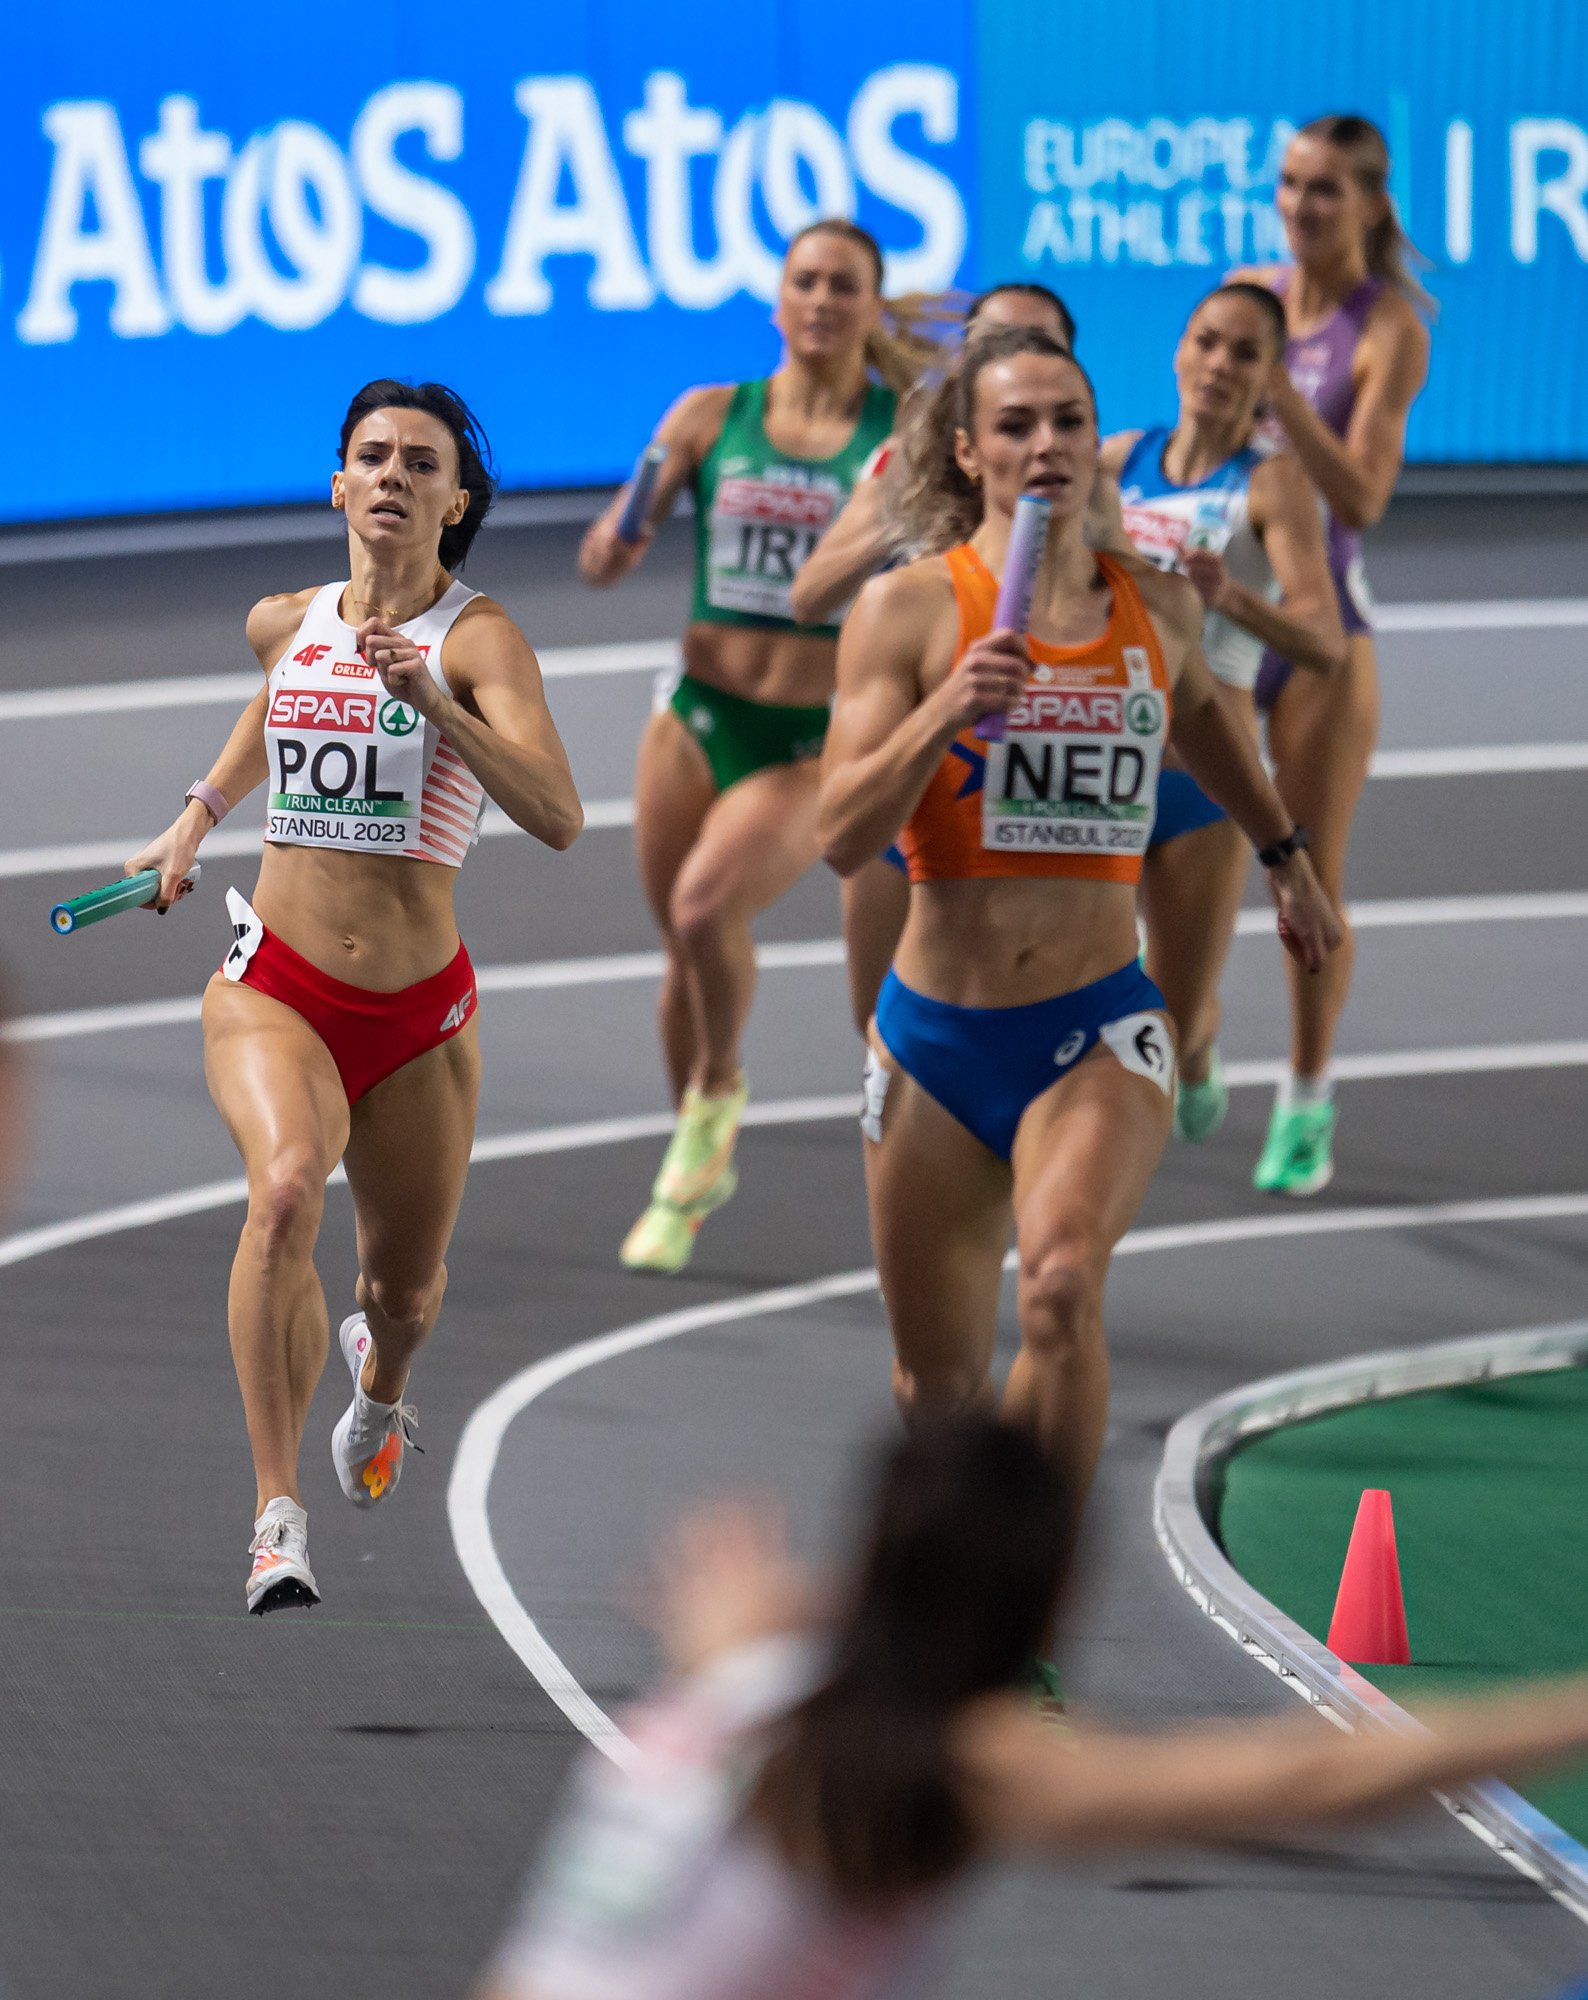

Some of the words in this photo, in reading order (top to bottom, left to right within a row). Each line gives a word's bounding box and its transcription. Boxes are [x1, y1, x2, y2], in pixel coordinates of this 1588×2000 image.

[293, 643, 333, 667] 4F
[334, 664, 373, 678] ORLEN
[272, 694, 371, 728] SPAR
[277, 738, 404, 801] POL
[1003, 742, 1145, 806] NED
[292, 795, 321, 811] RUN
[270, 816, 349, 840] STANBUL
[353, 822, 406, 843] 2023
